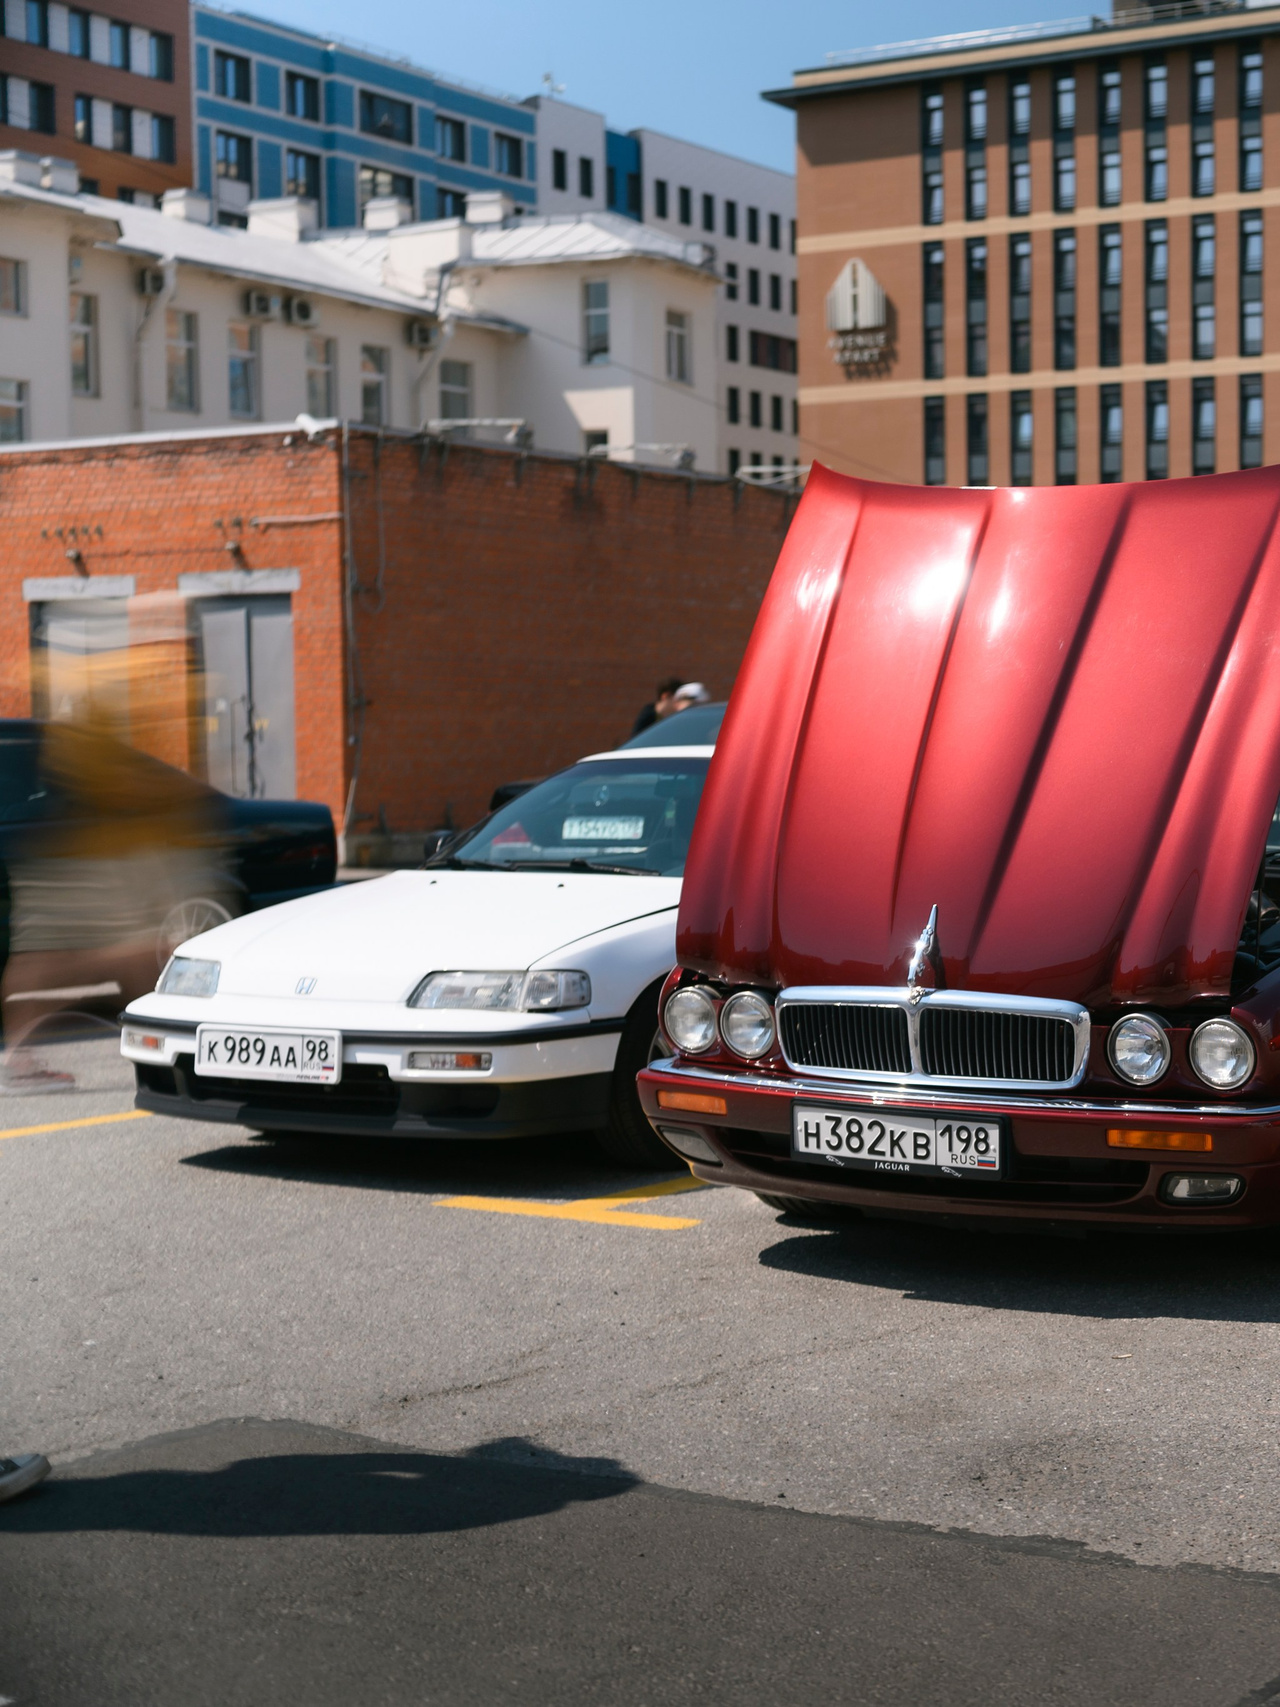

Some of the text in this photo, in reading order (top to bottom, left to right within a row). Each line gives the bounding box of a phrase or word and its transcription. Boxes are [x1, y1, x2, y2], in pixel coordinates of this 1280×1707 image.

[305, 1039, 329, 1062] 98
[939, 1124, 991, 1155] 198
[874, 1161, 911, 1173] JAGUAR
[950, 1154, 977, 1166] RUS
